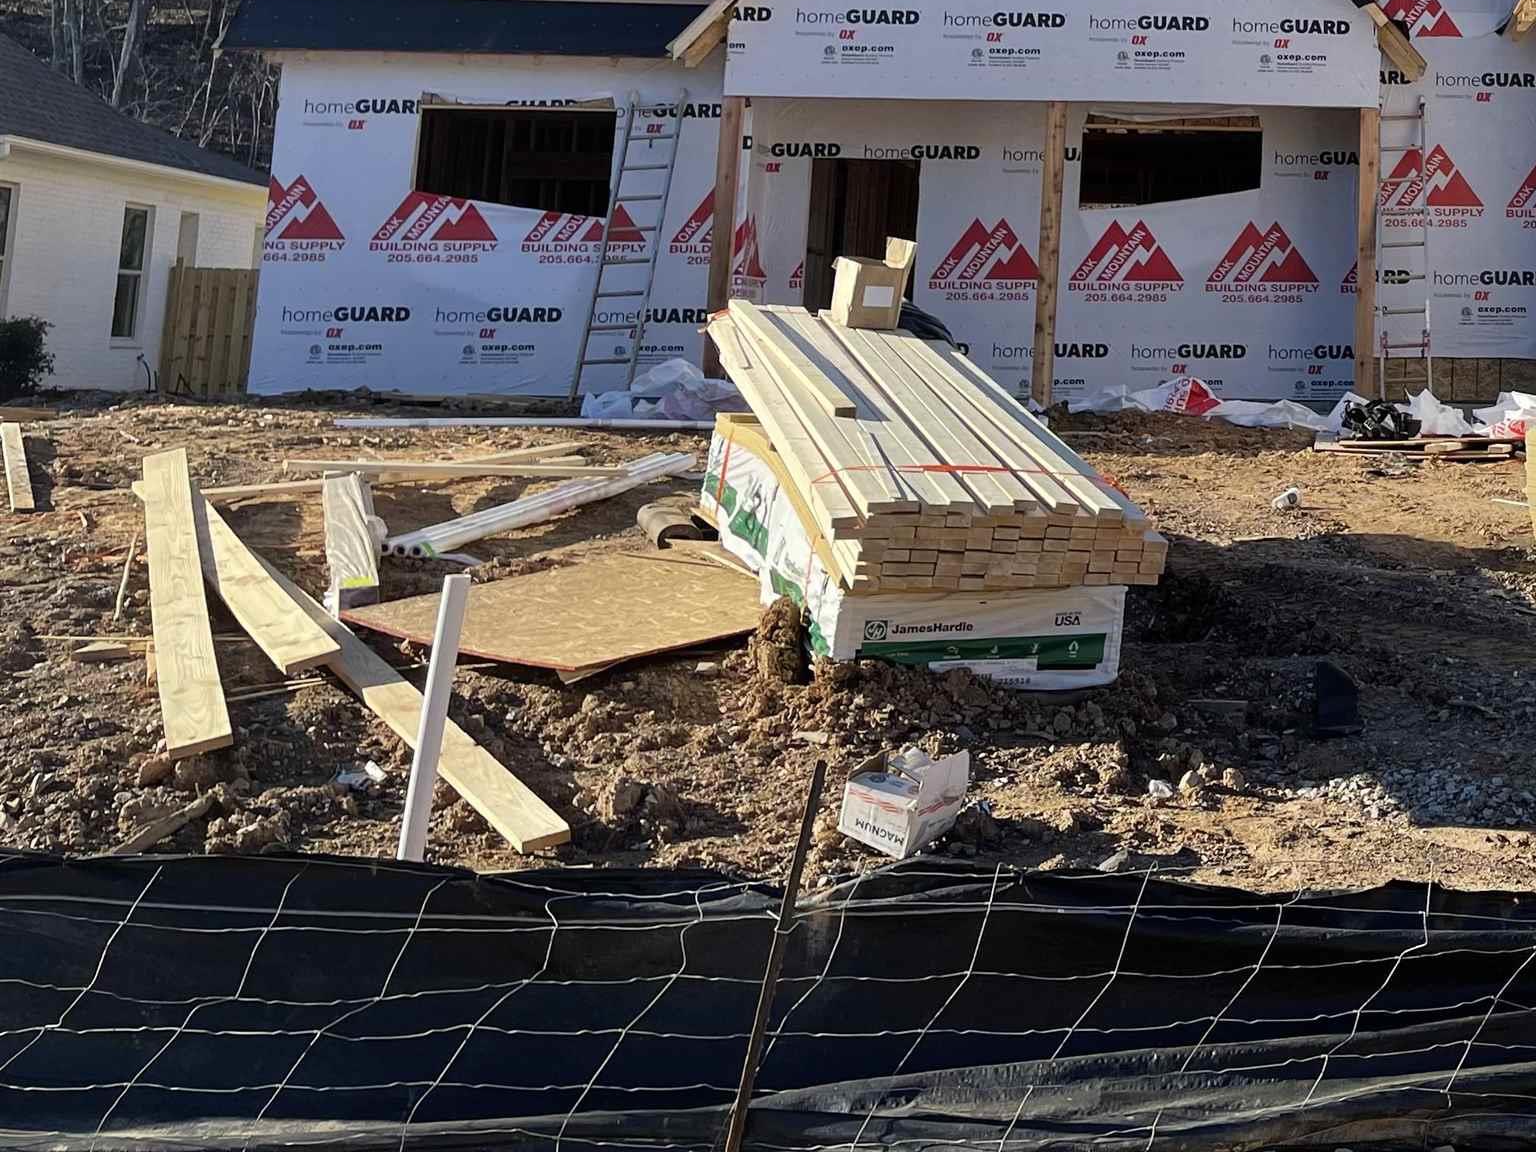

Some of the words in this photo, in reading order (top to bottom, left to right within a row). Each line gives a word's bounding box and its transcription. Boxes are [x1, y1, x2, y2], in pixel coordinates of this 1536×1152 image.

[796, 8, 920, 25] homeGUARD
[944, 12, 1066, 28] homeGUARD
[1089, 15, 1209, 31] homeGUARD
[1232, 18, 1350, 35] homeGUARD
[839, 29, 856, 40] OX
[986, 32, 1003, 43] OX
[1131, 35, 1148, 46] OX
[1274, 39, 1290, 49] OX
[1476, 92, 1492, 102] OX
[347, 119, 366, 129] OX
[863, 144, 980, 160] homeGUARD
[1513, 185, 1534, 207] OAK
[1434, 208, 1484, 217] SUPPLY
[378, 216, 403, 242] OAK
[529, 218, 553, 242] OAK
[678, 219, 699, 242] OAK
[291, 240, 346, 250] SUPPLY
[369, 241, 435, 252] BUILDING
[441, 241, 498, 252] SUPPLY
[522, 242, 588, 253] BUILDING
[387, 253, 478, 264] 205.664.2985
[962, 227, 1008, 279] MOUNTAIN
[1101, 229, 1147, 282] MOUNTAIN
[1239, 230, 1282, 282] MOUNTAIN
[936, 255, 957, 279] OAK
[1074, 259, 1097, 282] OAK
[1212, 259, 1235, 282] OAK
[928, 280, 992, 290] BUILDING
[1068, 282, 1130, 293] BUILDING
[1135, 283, 1184, 294] SUPPLY
[1205, 283, 1266, 294] BUILDING
[1271, 284, 1320, 295] SUPPLY
[945, 291, 1029, 301] 205.664.2985
[1084, 293, 1167, 303] 205.664.2985
[1222, 294, 1304, 304] 205.664.2985
[1474, 290, 1490, 301] OX
[281, 305, 410, 322] homeGUARD
[434, 307, 562, 323] homeGUARD
[325, 327, 343, 338] OX
[478, 328, 496, 339] OX
[1131, 343, 1246, 359] homeGUARD
[1172, 364, 1187, 374] OX
[1308, 364, 1322, 375] OX
[1055, 615, 1081, 626] USA
[891, 622, 974, 635] JamesHardie
[856, 817, 905, 847] MAGNUM
